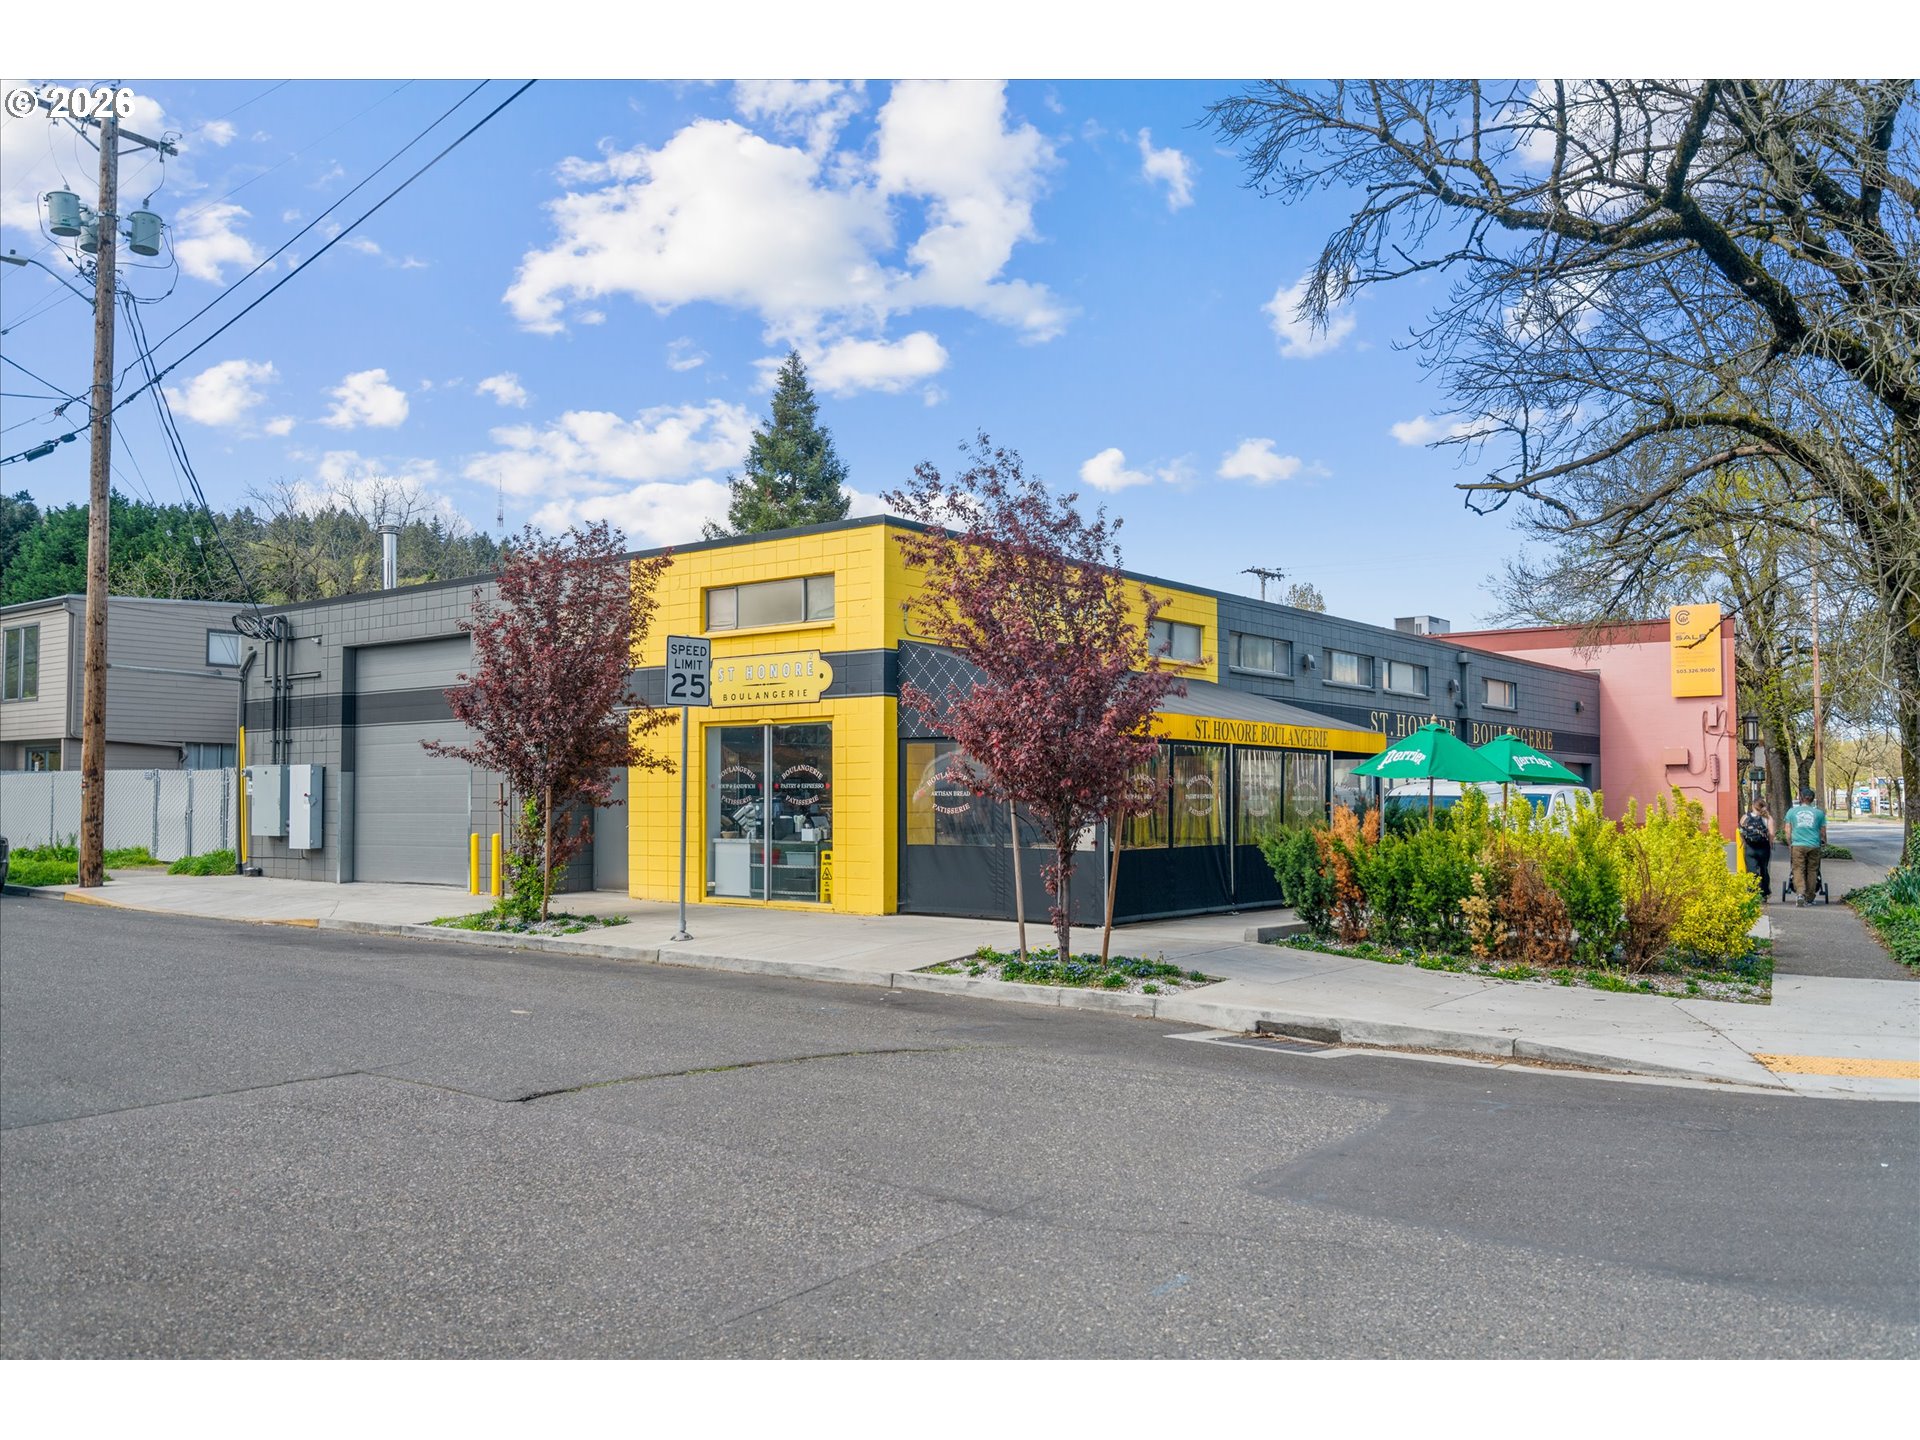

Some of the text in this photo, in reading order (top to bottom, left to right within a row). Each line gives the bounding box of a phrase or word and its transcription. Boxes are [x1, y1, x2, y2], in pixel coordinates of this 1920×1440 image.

[671, 644, 707, 657] SPEED
[674, 659, 703, 670] LIMIT
[718, 666, 735, 682] ST
[671, 673, 706, 698] 25
[723, 689, 807, 701] BOULANGERIE
[1195, 719, 1328, 748] ST. HONORE BOULANGERIE
[1396, 714, 1456, 738] HOE
[1473, 722, 1554, 750] BOUGERIE
[781, 764, 823, 780] BOULANGERIE
[785, 794, 820, 806] PATISSERIE
[932, 802, 971, 815] PATISSERIE
